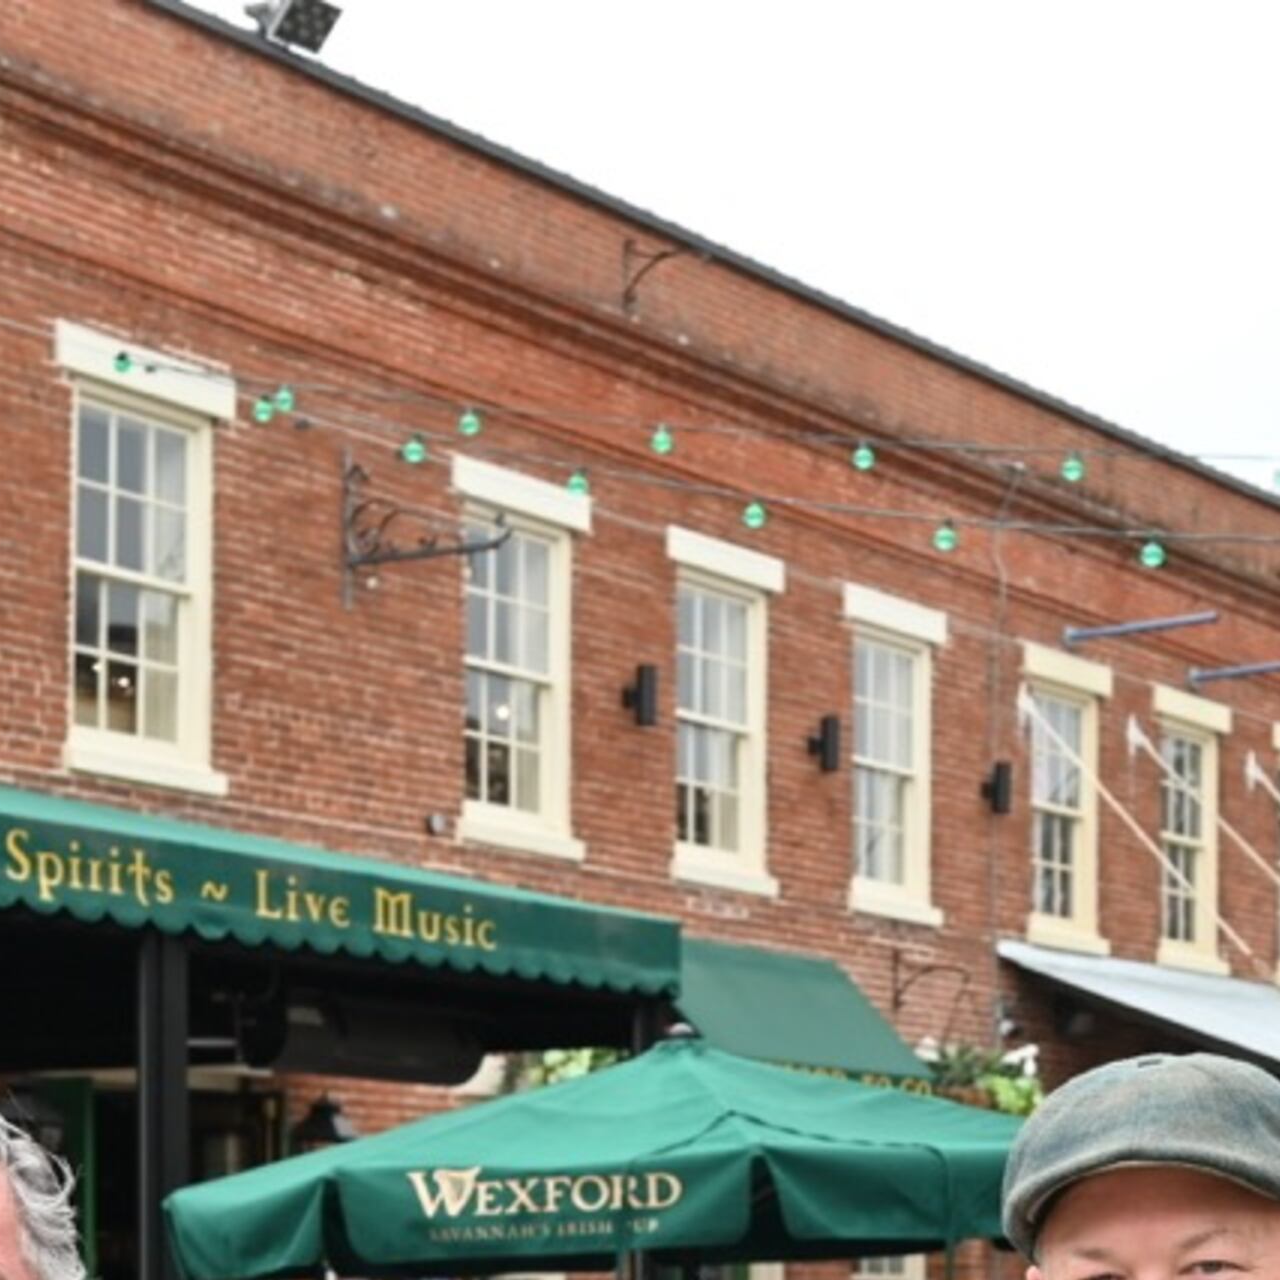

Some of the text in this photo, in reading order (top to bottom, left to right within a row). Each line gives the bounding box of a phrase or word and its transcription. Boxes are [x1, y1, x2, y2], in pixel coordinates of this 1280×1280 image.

[5, 828, 175, 906] Spirits
[255, 869, 351, 927] Live
[374, 887, 497, 951] Music
[407, 1166, 683, 1219] WEXFORD
